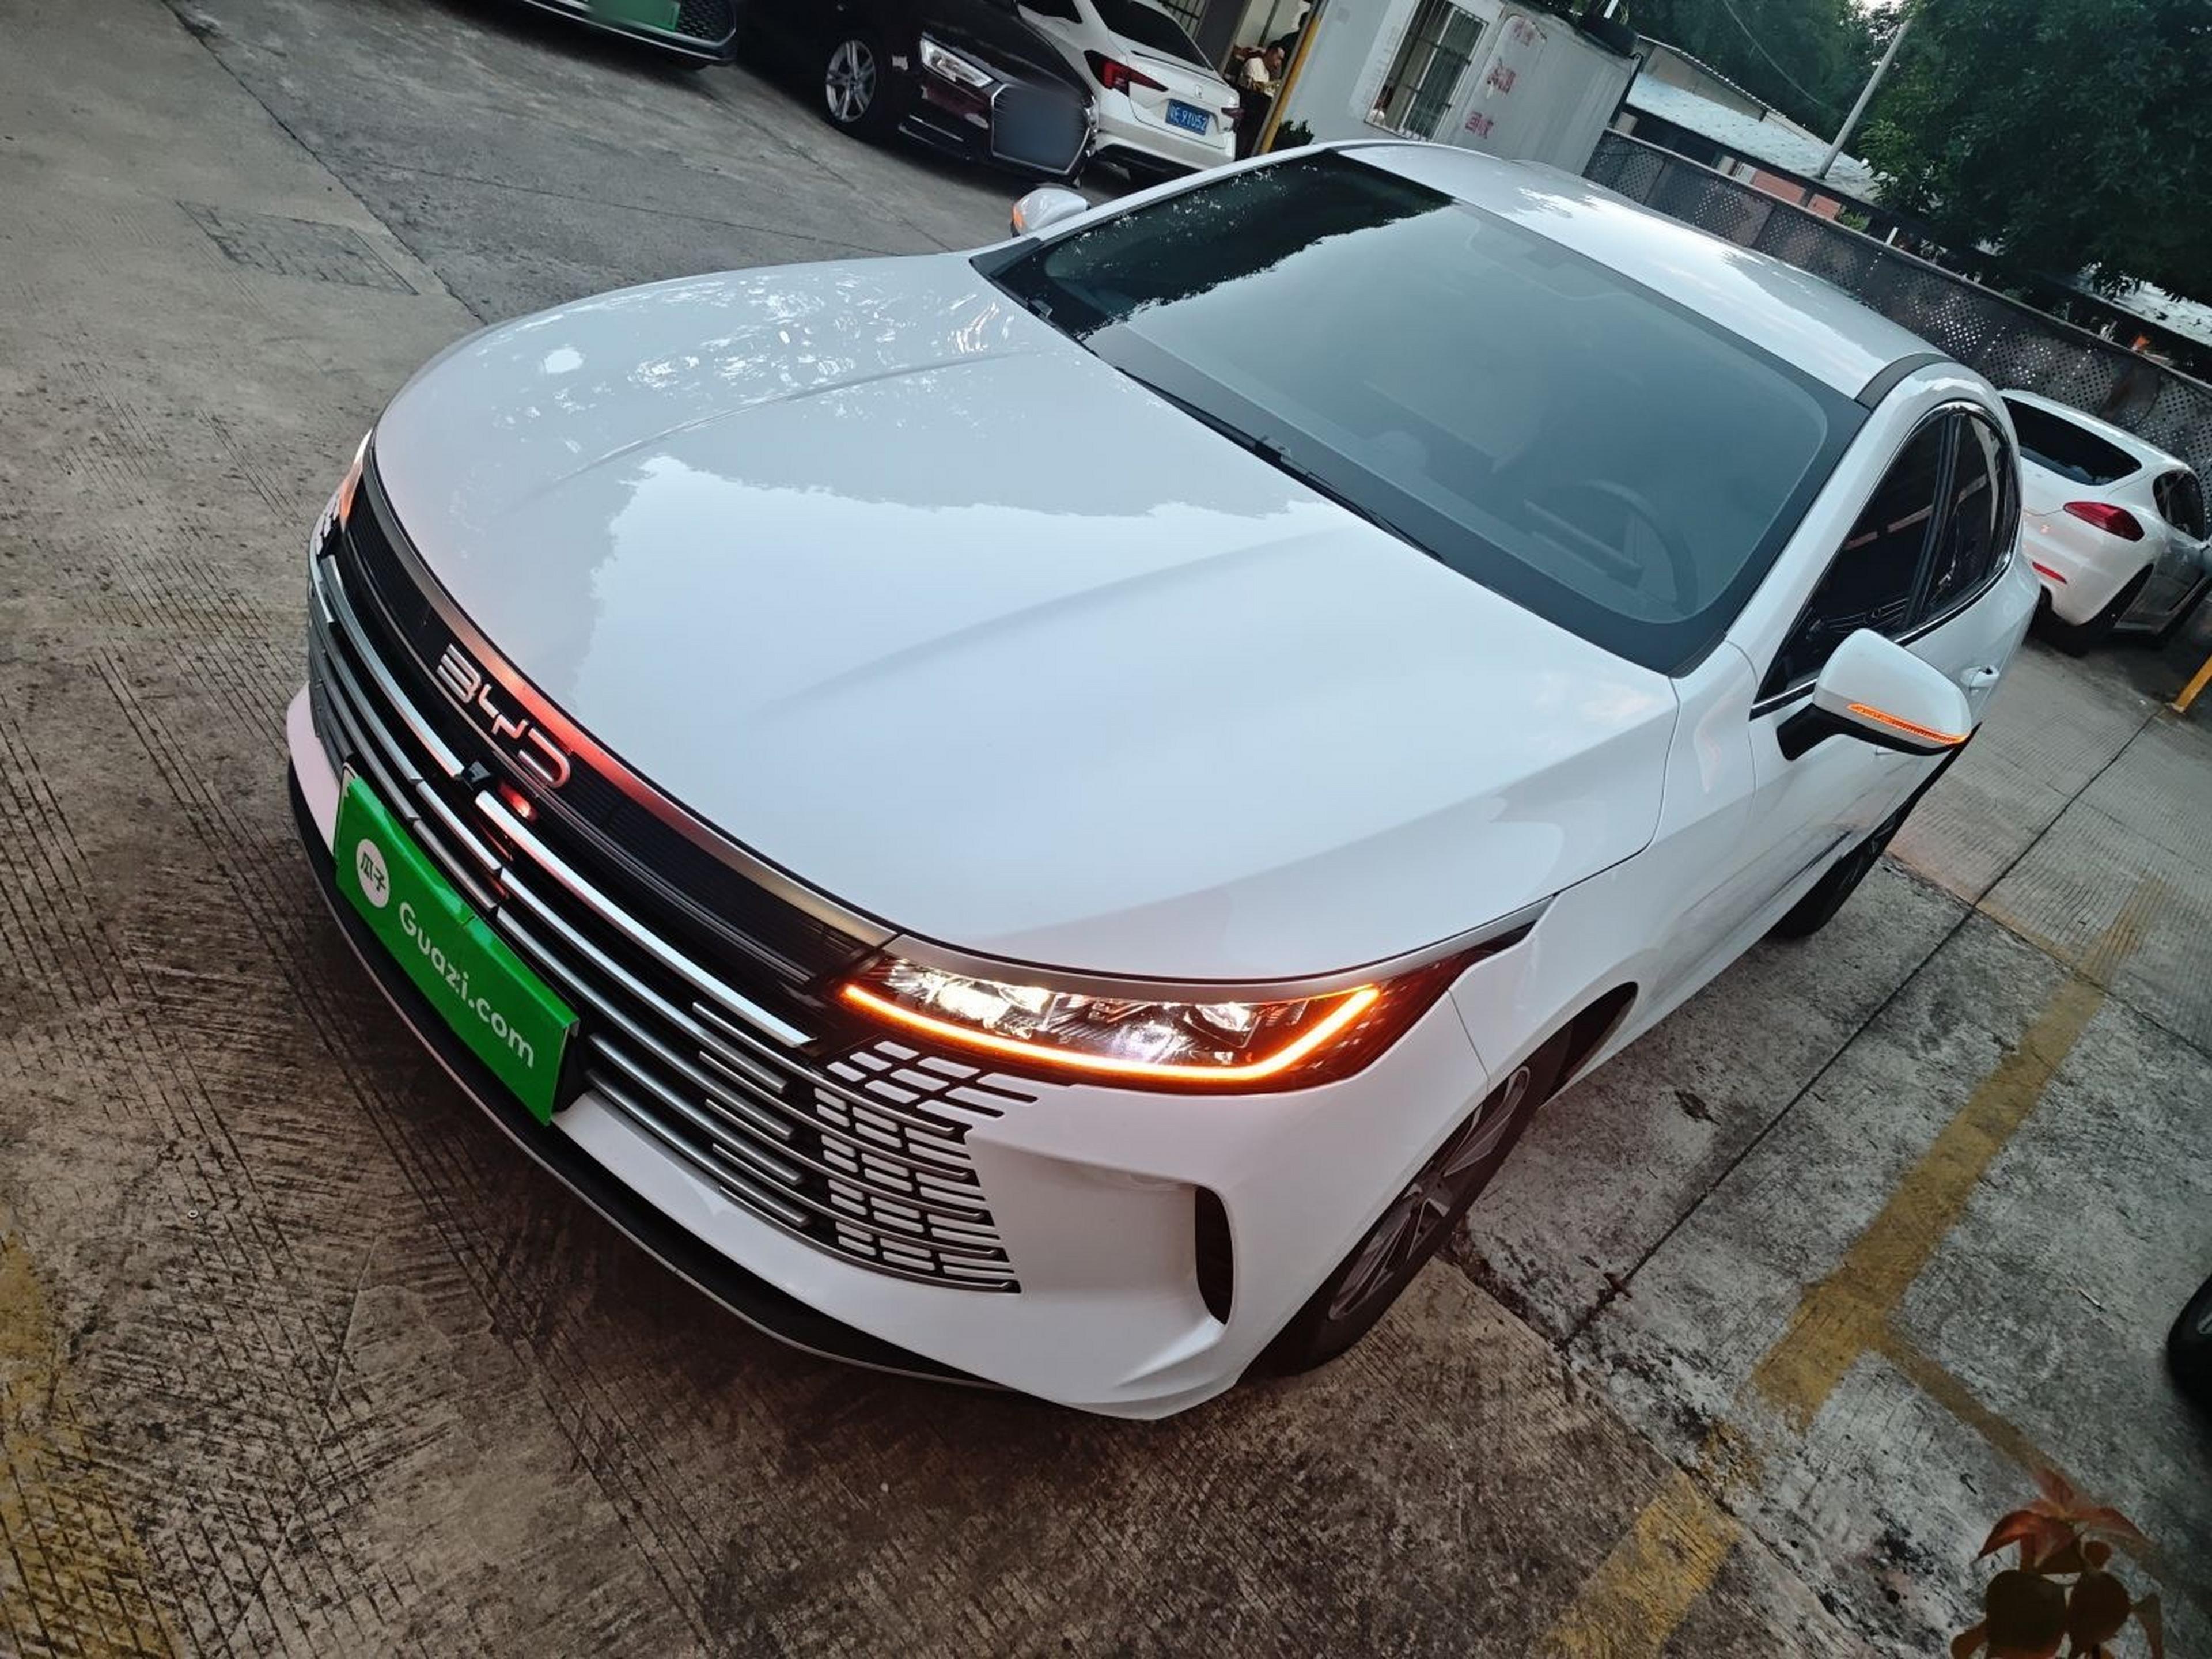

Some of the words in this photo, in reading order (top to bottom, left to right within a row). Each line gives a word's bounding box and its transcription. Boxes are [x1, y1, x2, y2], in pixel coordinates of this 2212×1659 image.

[436, 643, 571, 788] BYD
[359, 851, 387, 892] 瓜子
[399, 902, 535, 1070] Guazi.com
